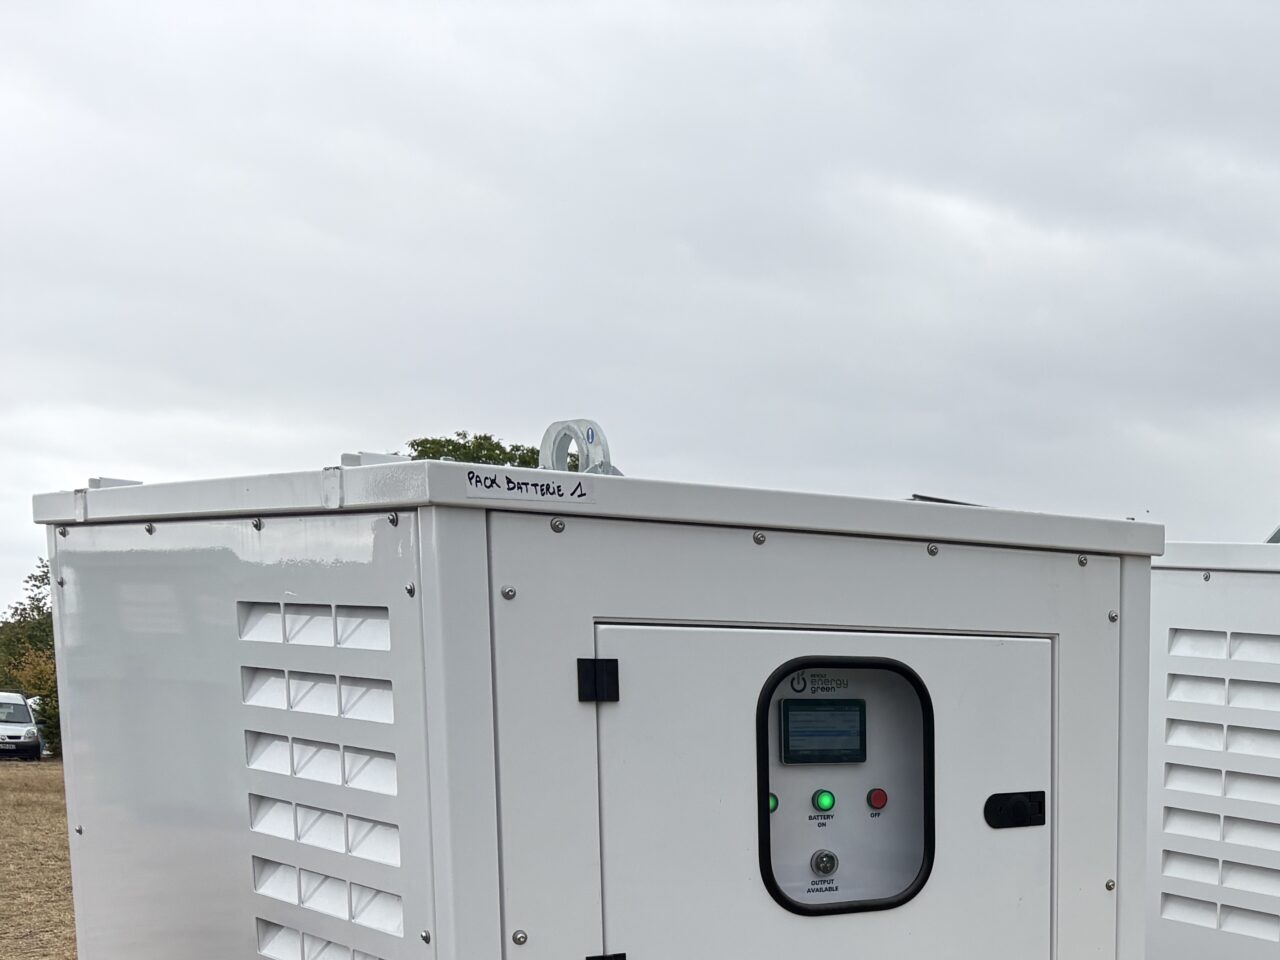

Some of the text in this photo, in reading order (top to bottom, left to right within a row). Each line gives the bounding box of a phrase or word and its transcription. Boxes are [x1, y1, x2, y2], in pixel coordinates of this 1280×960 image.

[467, 470, 501, 489] PACK
[570, 481, 587, 498] 1
[810, 678, 849, 689] energy
[810, 686, 836, 694] green
[806, 886, 839, 894] AVAILABLE
